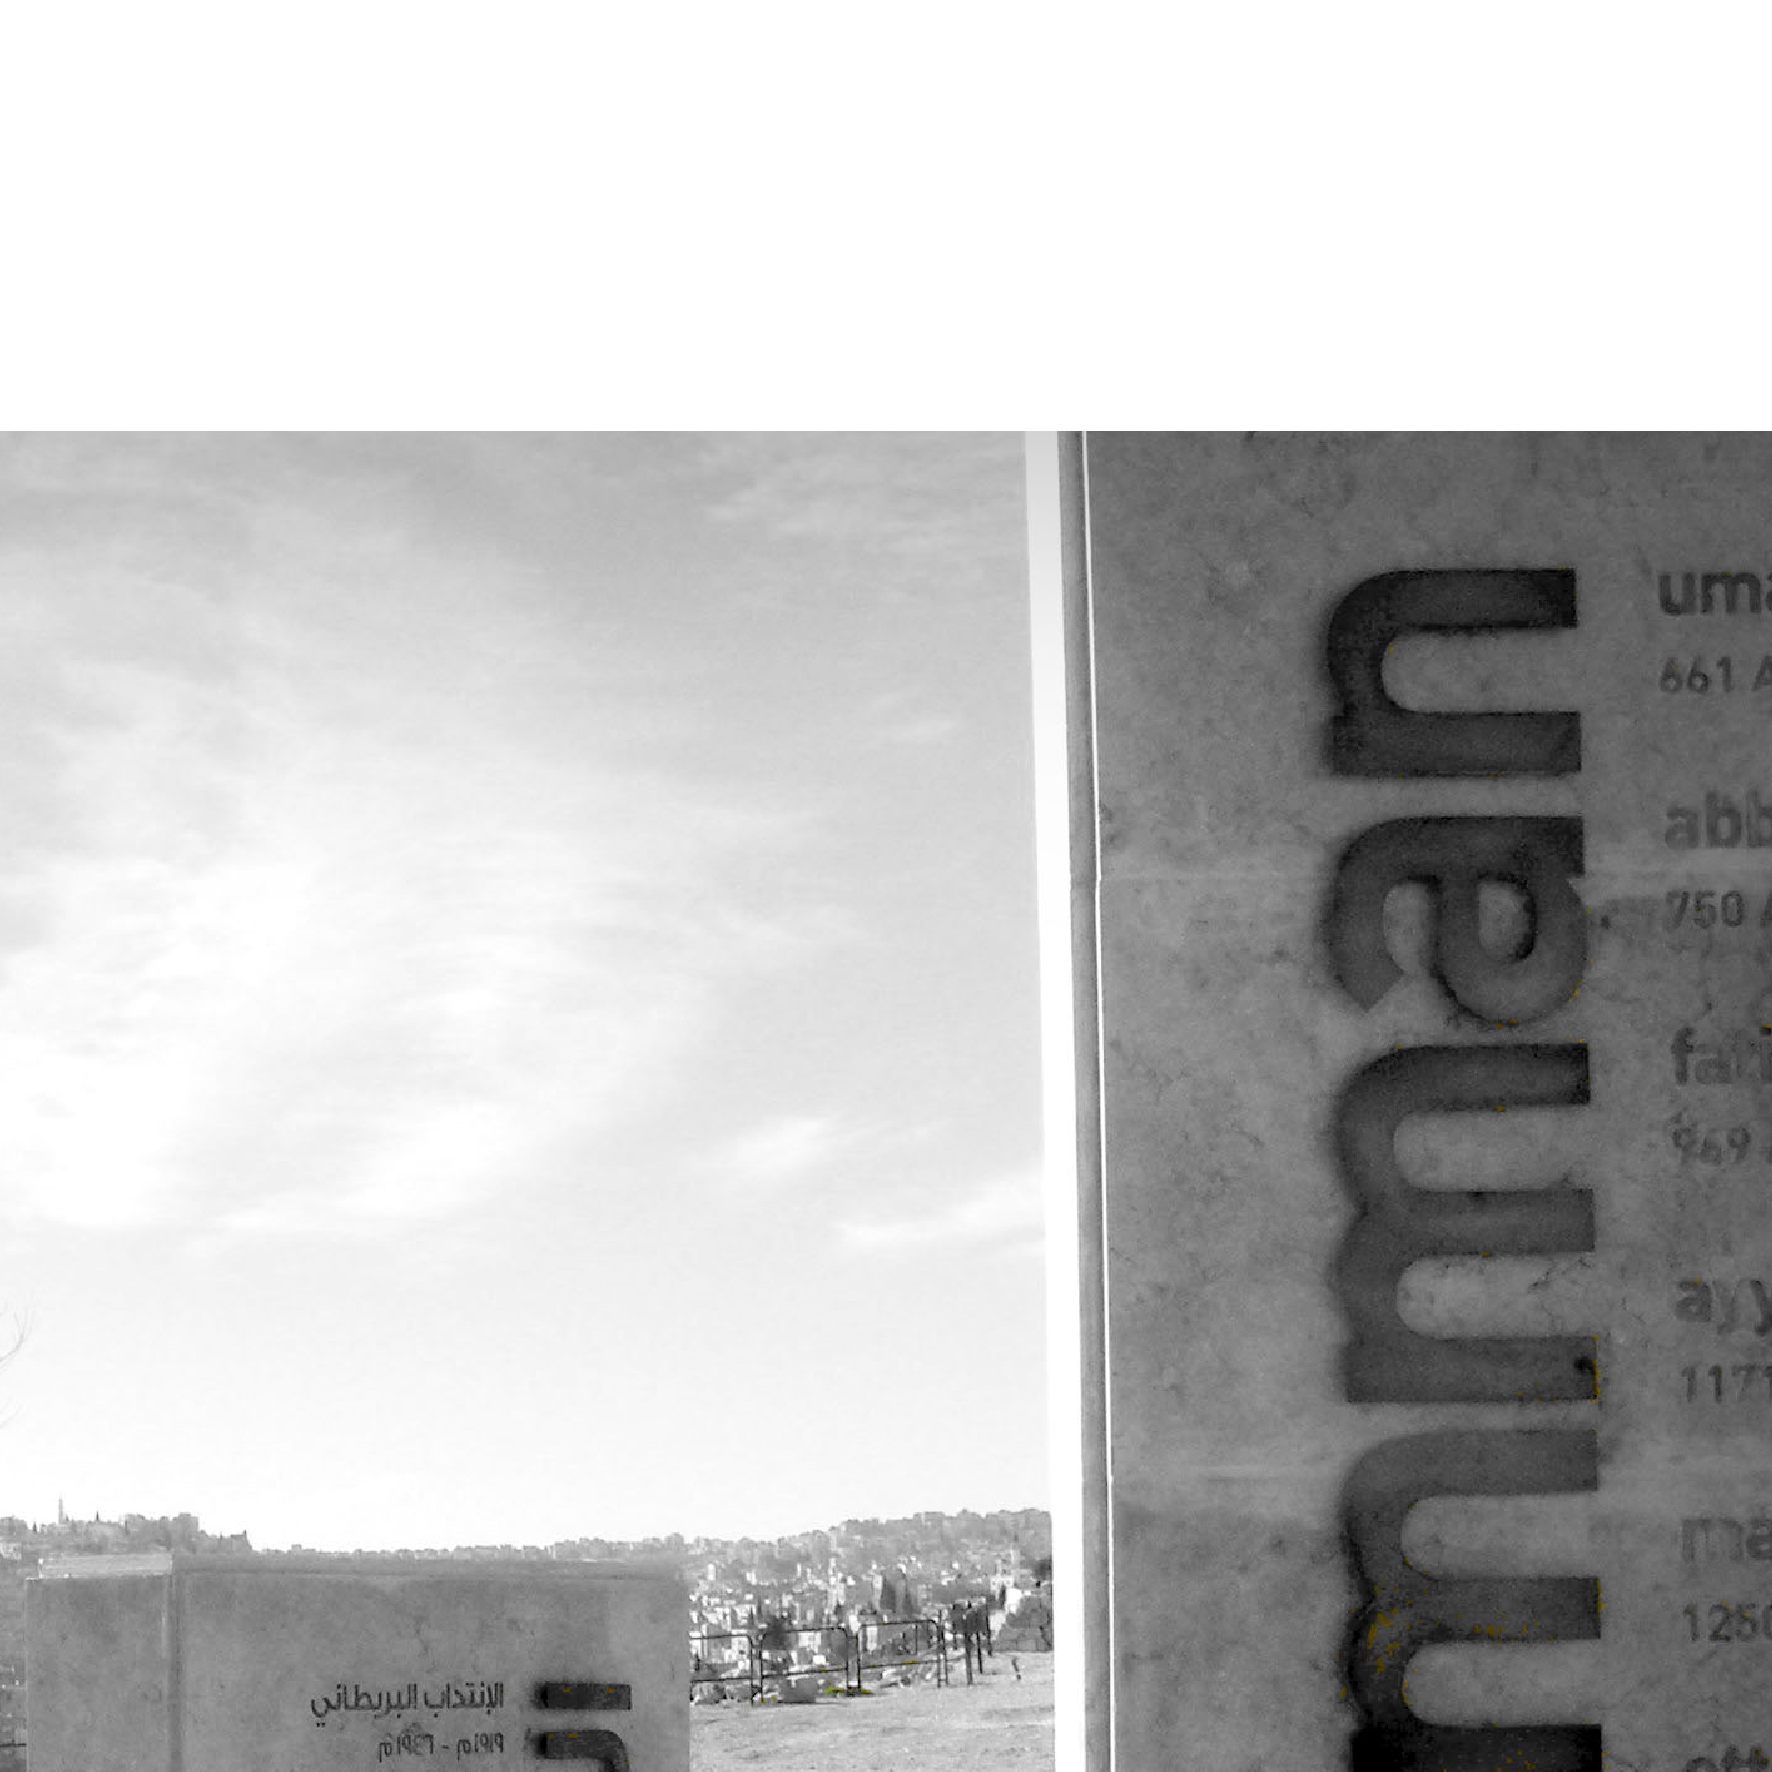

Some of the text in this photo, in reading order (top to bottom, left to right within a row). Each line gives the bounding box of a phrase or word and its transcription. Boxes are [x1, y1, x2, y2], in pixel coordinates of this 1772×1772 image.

[1661, 655, 1734, 694] 661
[1665, 888, 1744, 930] 750
[311, 1684, 417, 1728] البريطاني
